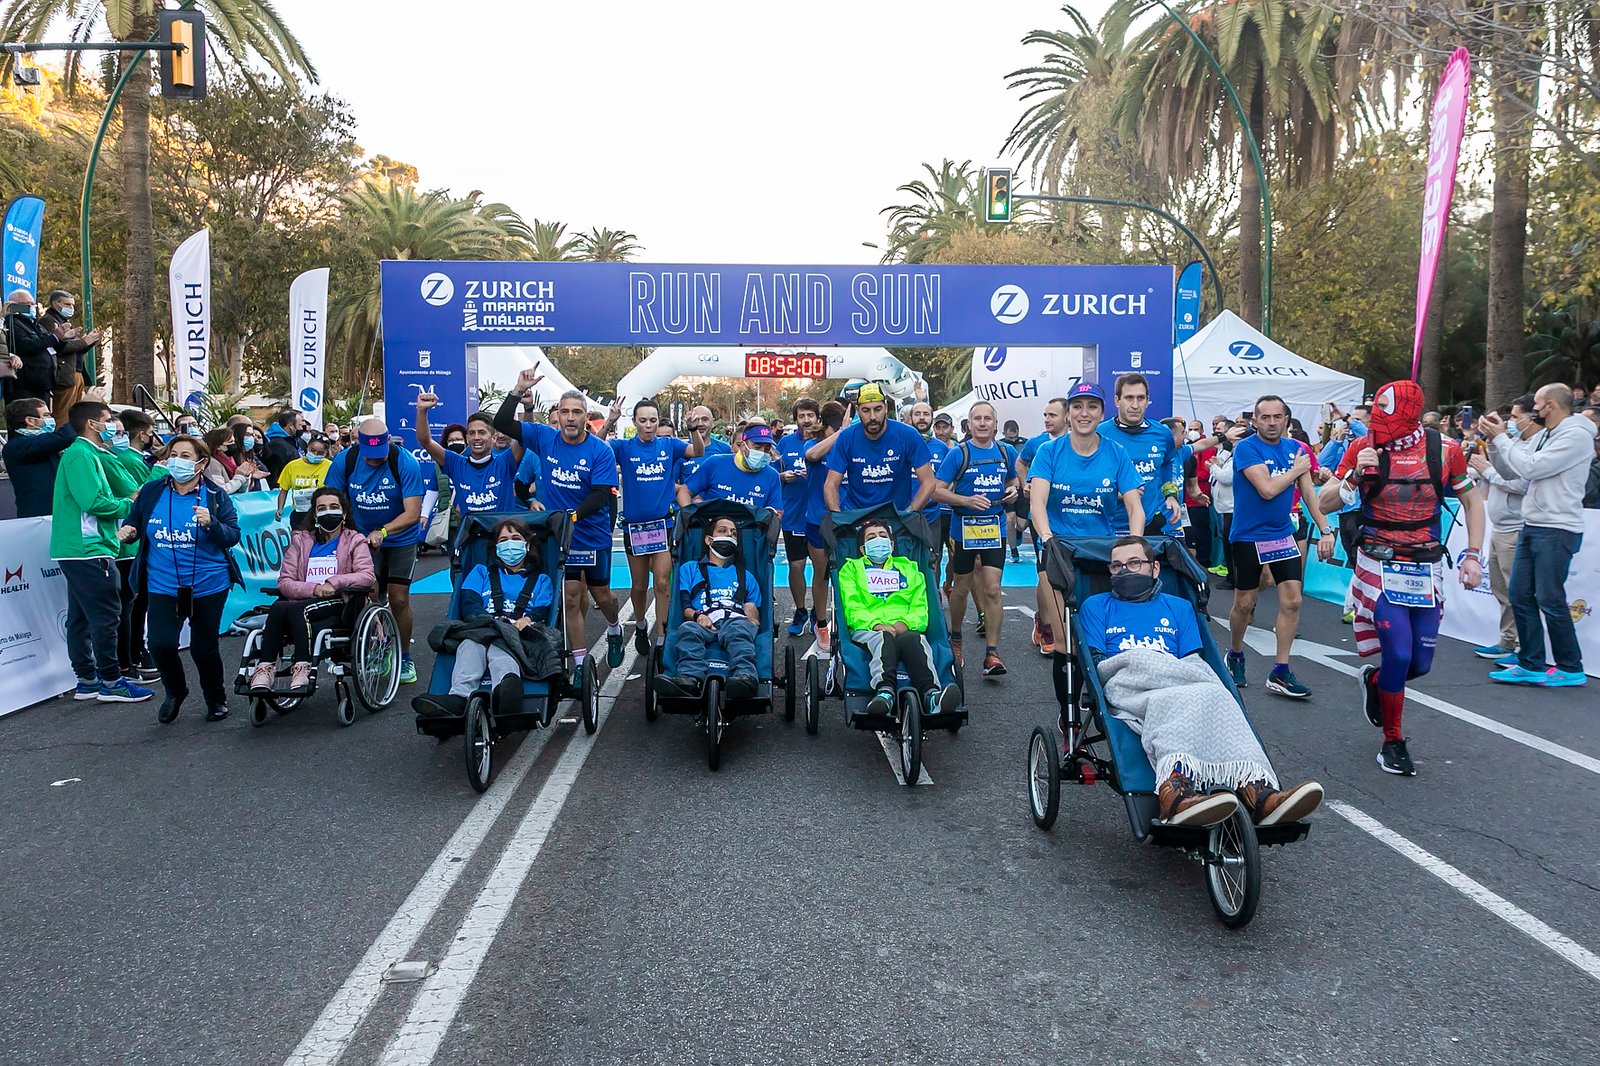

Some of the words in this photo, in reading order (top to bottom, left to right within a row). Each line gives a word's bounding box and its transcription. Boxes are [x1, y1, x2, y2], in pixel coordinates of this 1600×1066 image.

[7, 273, 31, 289] ZURICH
[464, 280, 554, 299] ZURICH
[482, 300, 554, 312] MARATÓN
[629, 272, 721, 334] RUN
[739, 272, 832, 335] AND
[850, 272, 941, 335] SUN
[1042, 294, 1147, 316] ZURICH
[483, 313, 545, 326] MÁLAGA
[184, 283, 207, 380] ZURICH
[303, 310, 317, 378] ZURICH
[748, 356, 824, 376] 08:52:00
[1209, 366, 1309, 377] ZURICH
[0, 582, 30, 594] HEALTH
[1404, 578, 1424, 587] 4392
